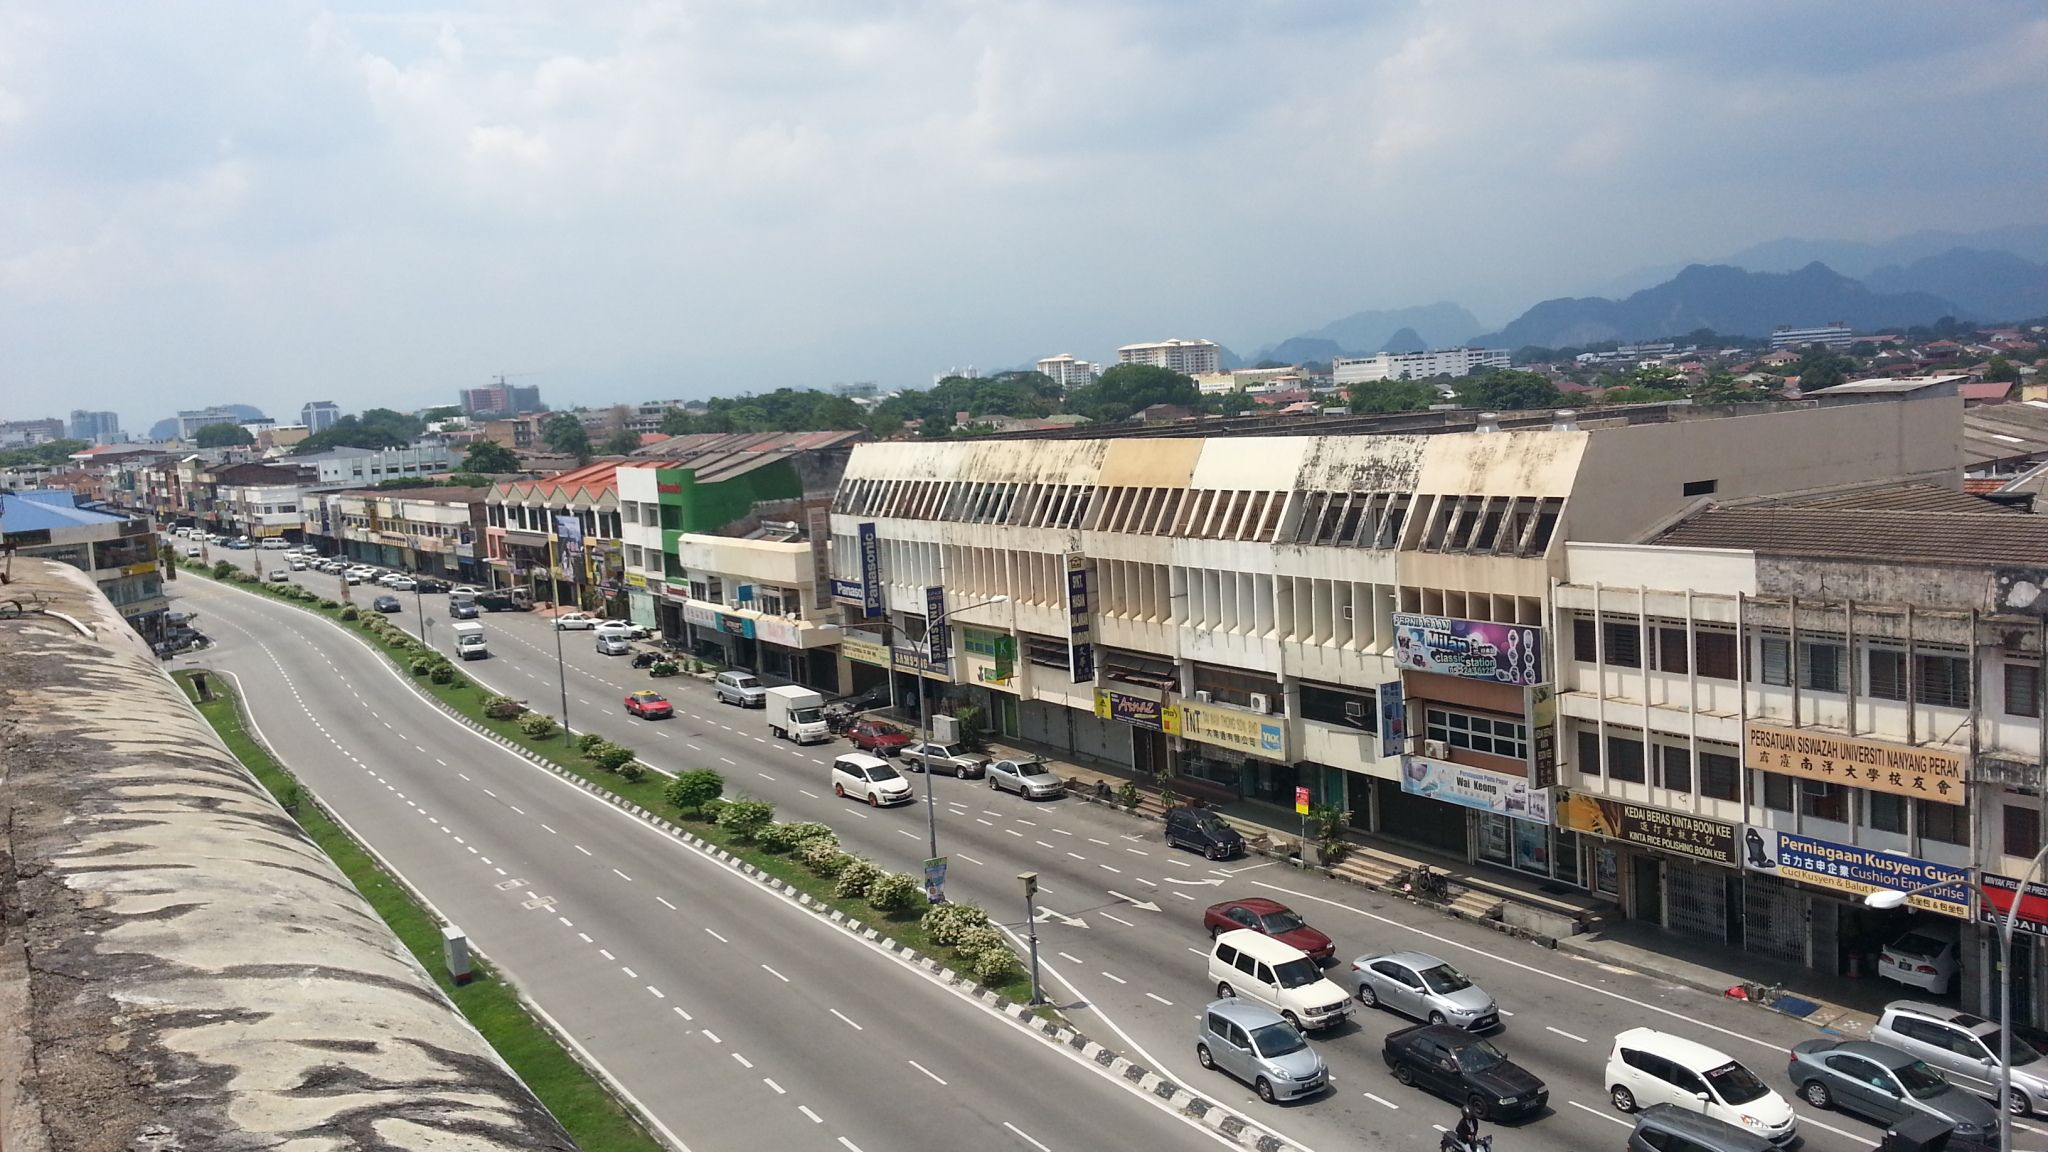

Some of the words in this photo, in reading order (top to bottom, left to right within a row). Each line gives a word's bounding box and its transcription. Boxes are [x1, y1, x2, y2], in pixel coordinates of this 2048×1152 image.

[863, 533, 879, 608] Panasonic
[837, 582, 863, 598] Panaso
[1393, 615, 1451, 631] PERNIAGAAN
[1426, 631, 1469, 652] Milan
[1435, 652, 1465, 663] classic
[1466, 656, 1495, 668] station
[1184, 707, 1200, 734] TNT
[1751, 729, 1795, 752] PERSATUAN
[1797, 737, 1838, 759] SISWAZAH
[1840, 742, 1884, 767] UNIVERSITI
[1887, 750, 1926, 774] NANYANG
[1929, 756, 1959, 779] PERAK
[1456, 776, 1470, 788] Wai
[1473, 780, 1497, 795] Keong
[1624, 805, 1646, 821] KEDAI
[1646, 810, 1671, 826] BERAS
[1671, 816, 1693, 830] KINTA
[1693, 821, 1715, 835] BOON
[1716, 825, 1732, 839] KEE
[1629, 831, 1646, 843] KINTA
[1647, 834, 1661, 846] RICE
[1661, 838, 1694, 854] POLISHING
[1694, 846, 1714, 858] BOON
[1713, 850, 1727, 861] KEE
[1780, 835, 1862, 865] Perniagaan
[1865, 852, 1920, 877] Kusyen
[1781, 866, 1800, 876] Cuci
[1802, 870, 1835, 883] Kusyen
[1836, 878, 1844, 887] &
[1845, 879, 1868, 893] Balut
[1850, 866, 1898, 887] Cushion
[1901, 877, 1965, 901] Enteprise
[1932, 901, 1938, 909] &
[1987, 912, 2036, 932] KEDAI
